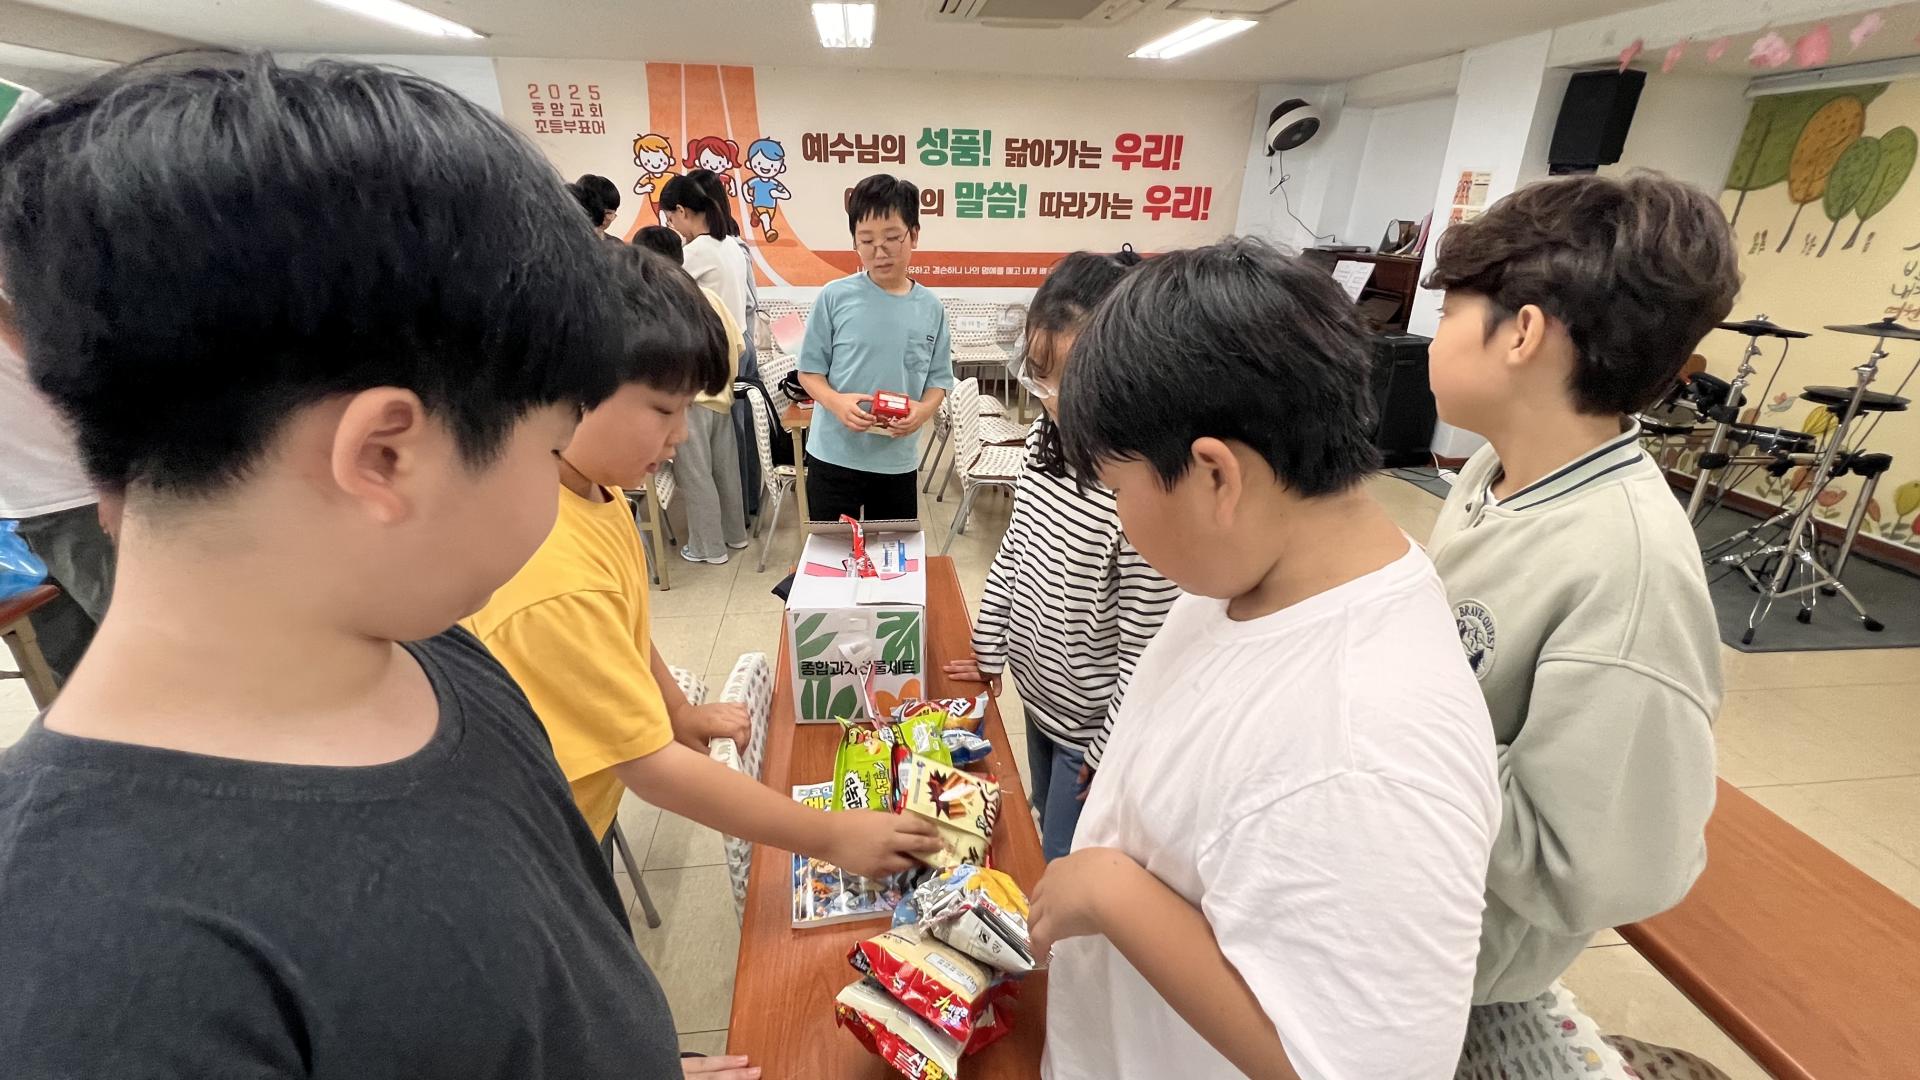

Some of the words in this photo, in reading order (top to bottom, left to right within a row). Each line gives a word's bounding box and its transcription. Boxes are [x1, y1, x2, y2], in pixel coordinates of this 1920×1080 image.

[528, 84, 601, 100] 2025
[531, 102, 603, 117] 후암교회
[801, 132, 906, 164] 예수님의
[917, 127, 992, 166] 성품!
[1004, 137, 1102, 169] 닮아가는
[1111, 133, 1184, 171] 우리!
[954, 182, 1028, 219] 말씀!
[1039, 191, 1133, 220] 따라가는
[1142, 185, 1213, 221] 우리!
[905, 266, 931, 274] 유하고
[1459, 605, 1485, 620] BRAVE
